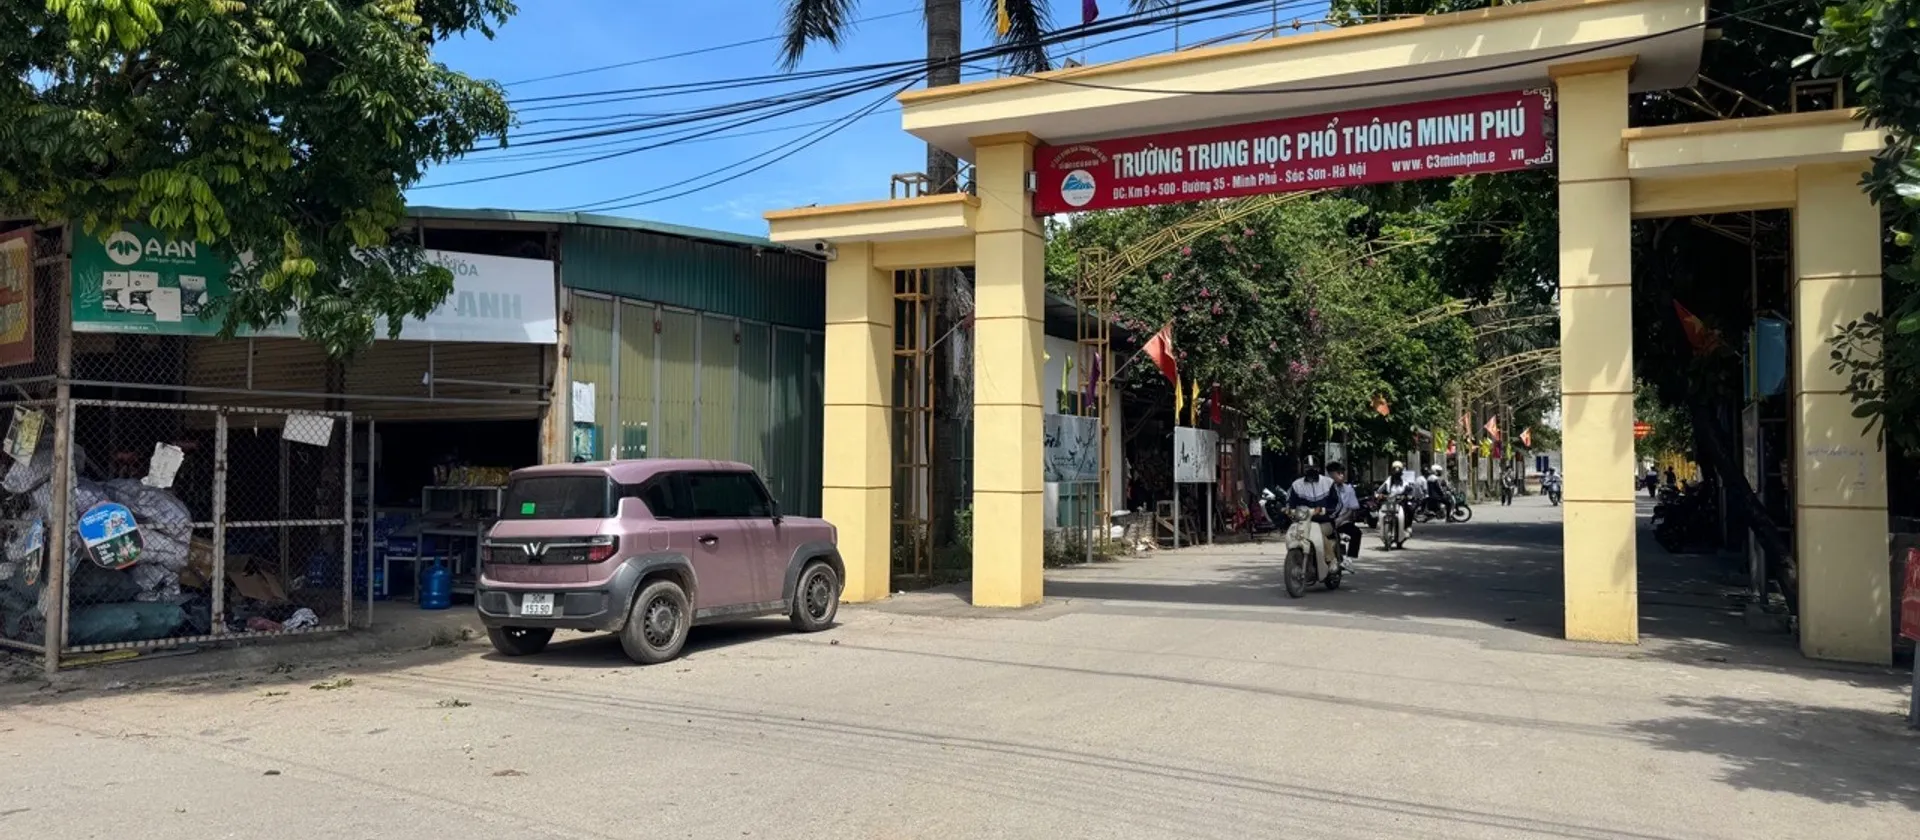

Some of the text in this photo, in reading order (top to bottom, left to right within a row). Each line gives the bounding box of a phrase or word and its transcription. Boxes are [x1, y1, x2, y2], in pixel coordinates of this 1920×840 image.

[1112, 142, 1183, 179] TRƯỜNG
[1187, 139, 1249, 171] TRUNG
[1253, 133, 1291, 169] HỌC
[1297, 116, 1339, 160] PHỔ
[1343, 117, 1413, 155] THÔNG
[1417, 112, 1475, 147] MINH
[1480, 100, 1526, 140] PHÚ
[1213, 177, 1225, 190] 35
[1232, 174, 1257, 188] Minh
[1285, 168, 1305, 183] Sóc
[1307, 167, 1326, 181] Sơn
[1332, 163, 1346, 178] Hà
[1348, 161, 1366, 179] Nội
[457, 290, 522, 319] ANH
